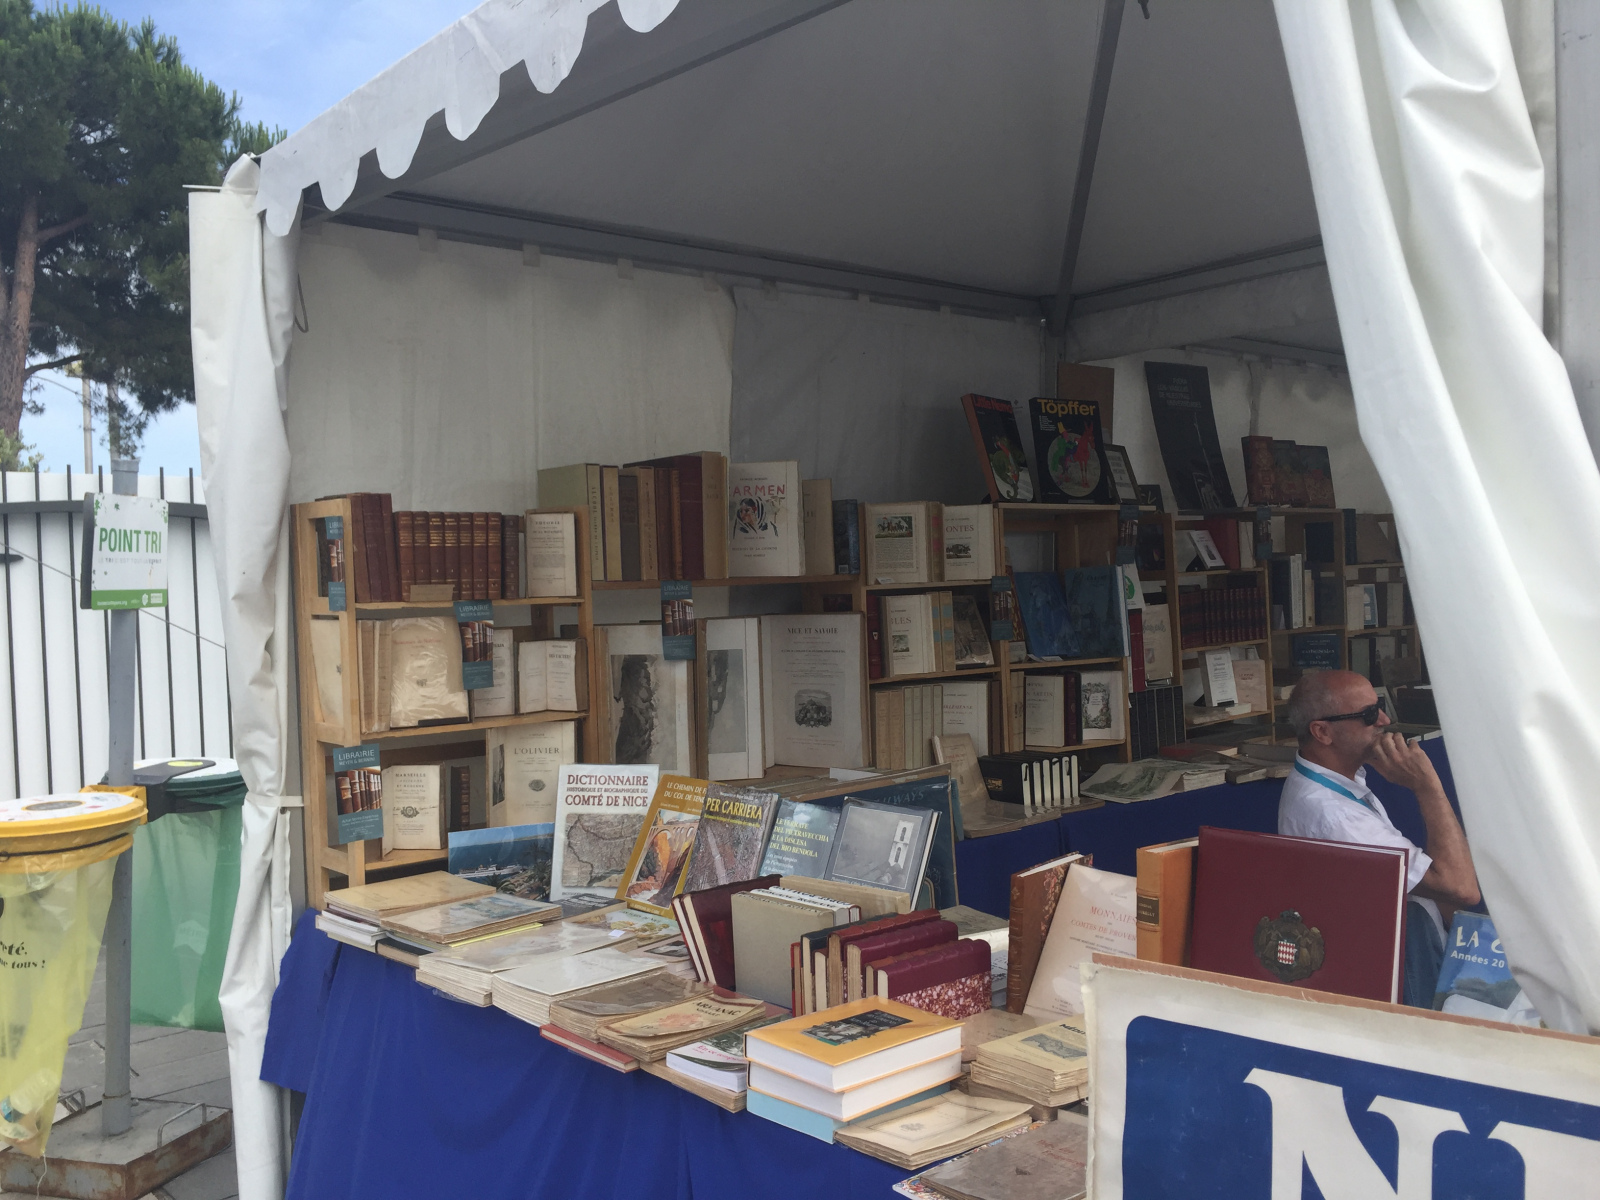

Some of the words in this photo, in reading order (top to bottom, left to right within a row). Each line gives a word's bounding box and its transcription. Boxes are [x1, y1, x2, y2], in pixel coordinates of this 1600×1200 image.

[1036, 398, 1096, 418] Töpffer
[730, 484, 785, 497] ARMEN
[98, 527, 142, 553] POINT
[144, 530, 162, 554] TRI
[338, 749, 375, 761] LIBRAIRIE
[514, 747, 560, 755] L'OLIVIER
[567, 774, 649, 786] DICTIONNAIRE
[673, 782, 694, 792] CHEMIN
[694, 785, 702, 793] DE
[565, 794, 603, 806] COMTÉ
[606, 795, 619, 806] DE
[622, 796, 648, 807] NICE
[673, 791, 684, 800] COL
[685, 793, 692, 801] DE
[705, 797, 721, 812] PER
[721, 800, 762, 820] CARRIERA
[776, 817, 783, 825] LE
[1090, 906, 1137, 925] MONNAIES
[1071, 919, 1097, 931] COMTES
[1098, 925, 1108, 934] DE
[1455, 925, 1479, 948] LA
[11, 960, 38, 969] tous
[1450, 949, 1488, 965] Années
[1491, 958, 1505, 969] 20
[1242, 1067, 1600, 1200] N
